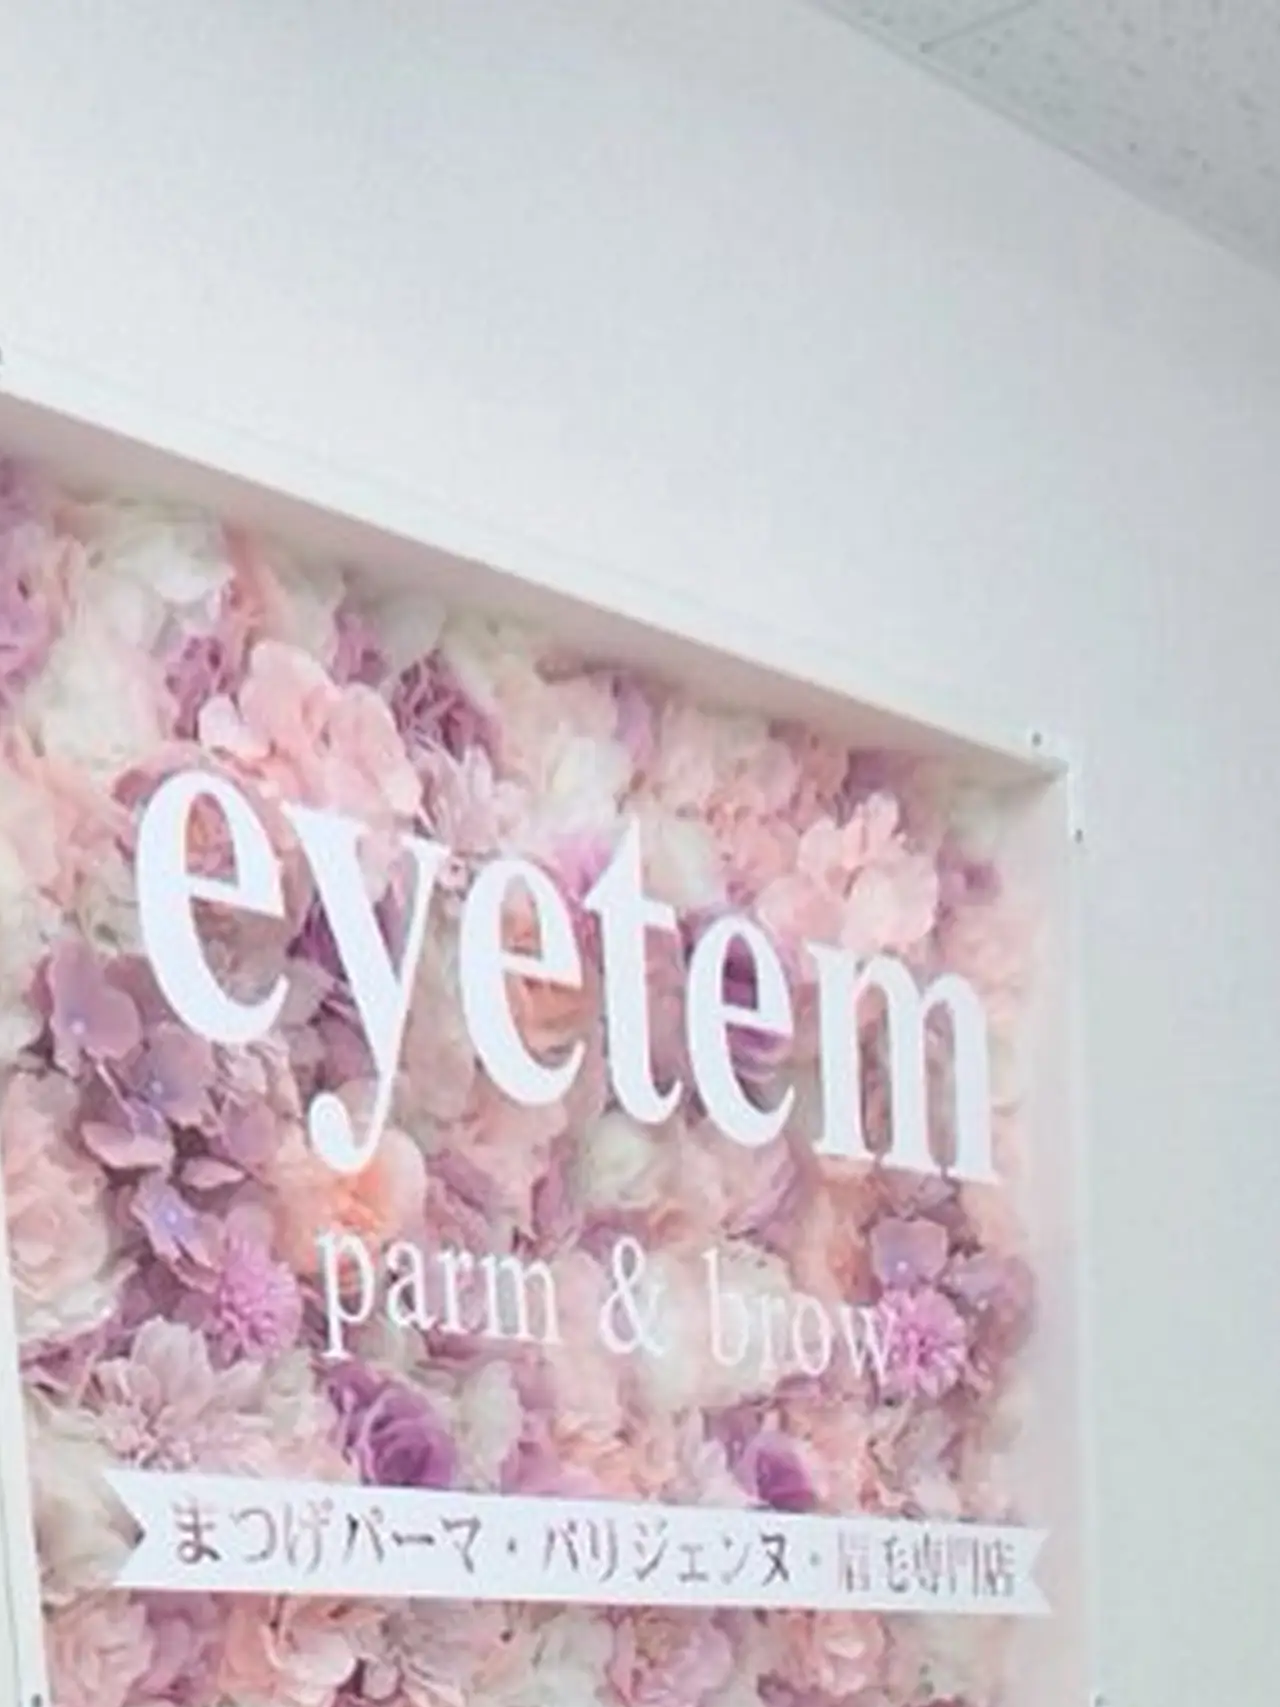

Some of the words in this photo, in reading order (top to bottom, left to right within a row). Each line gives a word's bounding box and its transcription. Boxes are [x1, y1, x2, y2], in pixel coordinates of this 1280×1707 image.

[135, 771, 1002, 1187] eyetem
[315, 1228, 562, 1361] parm
[598, 1235, 667, 1358] &
[703, 1247, 900, 1386] brow
